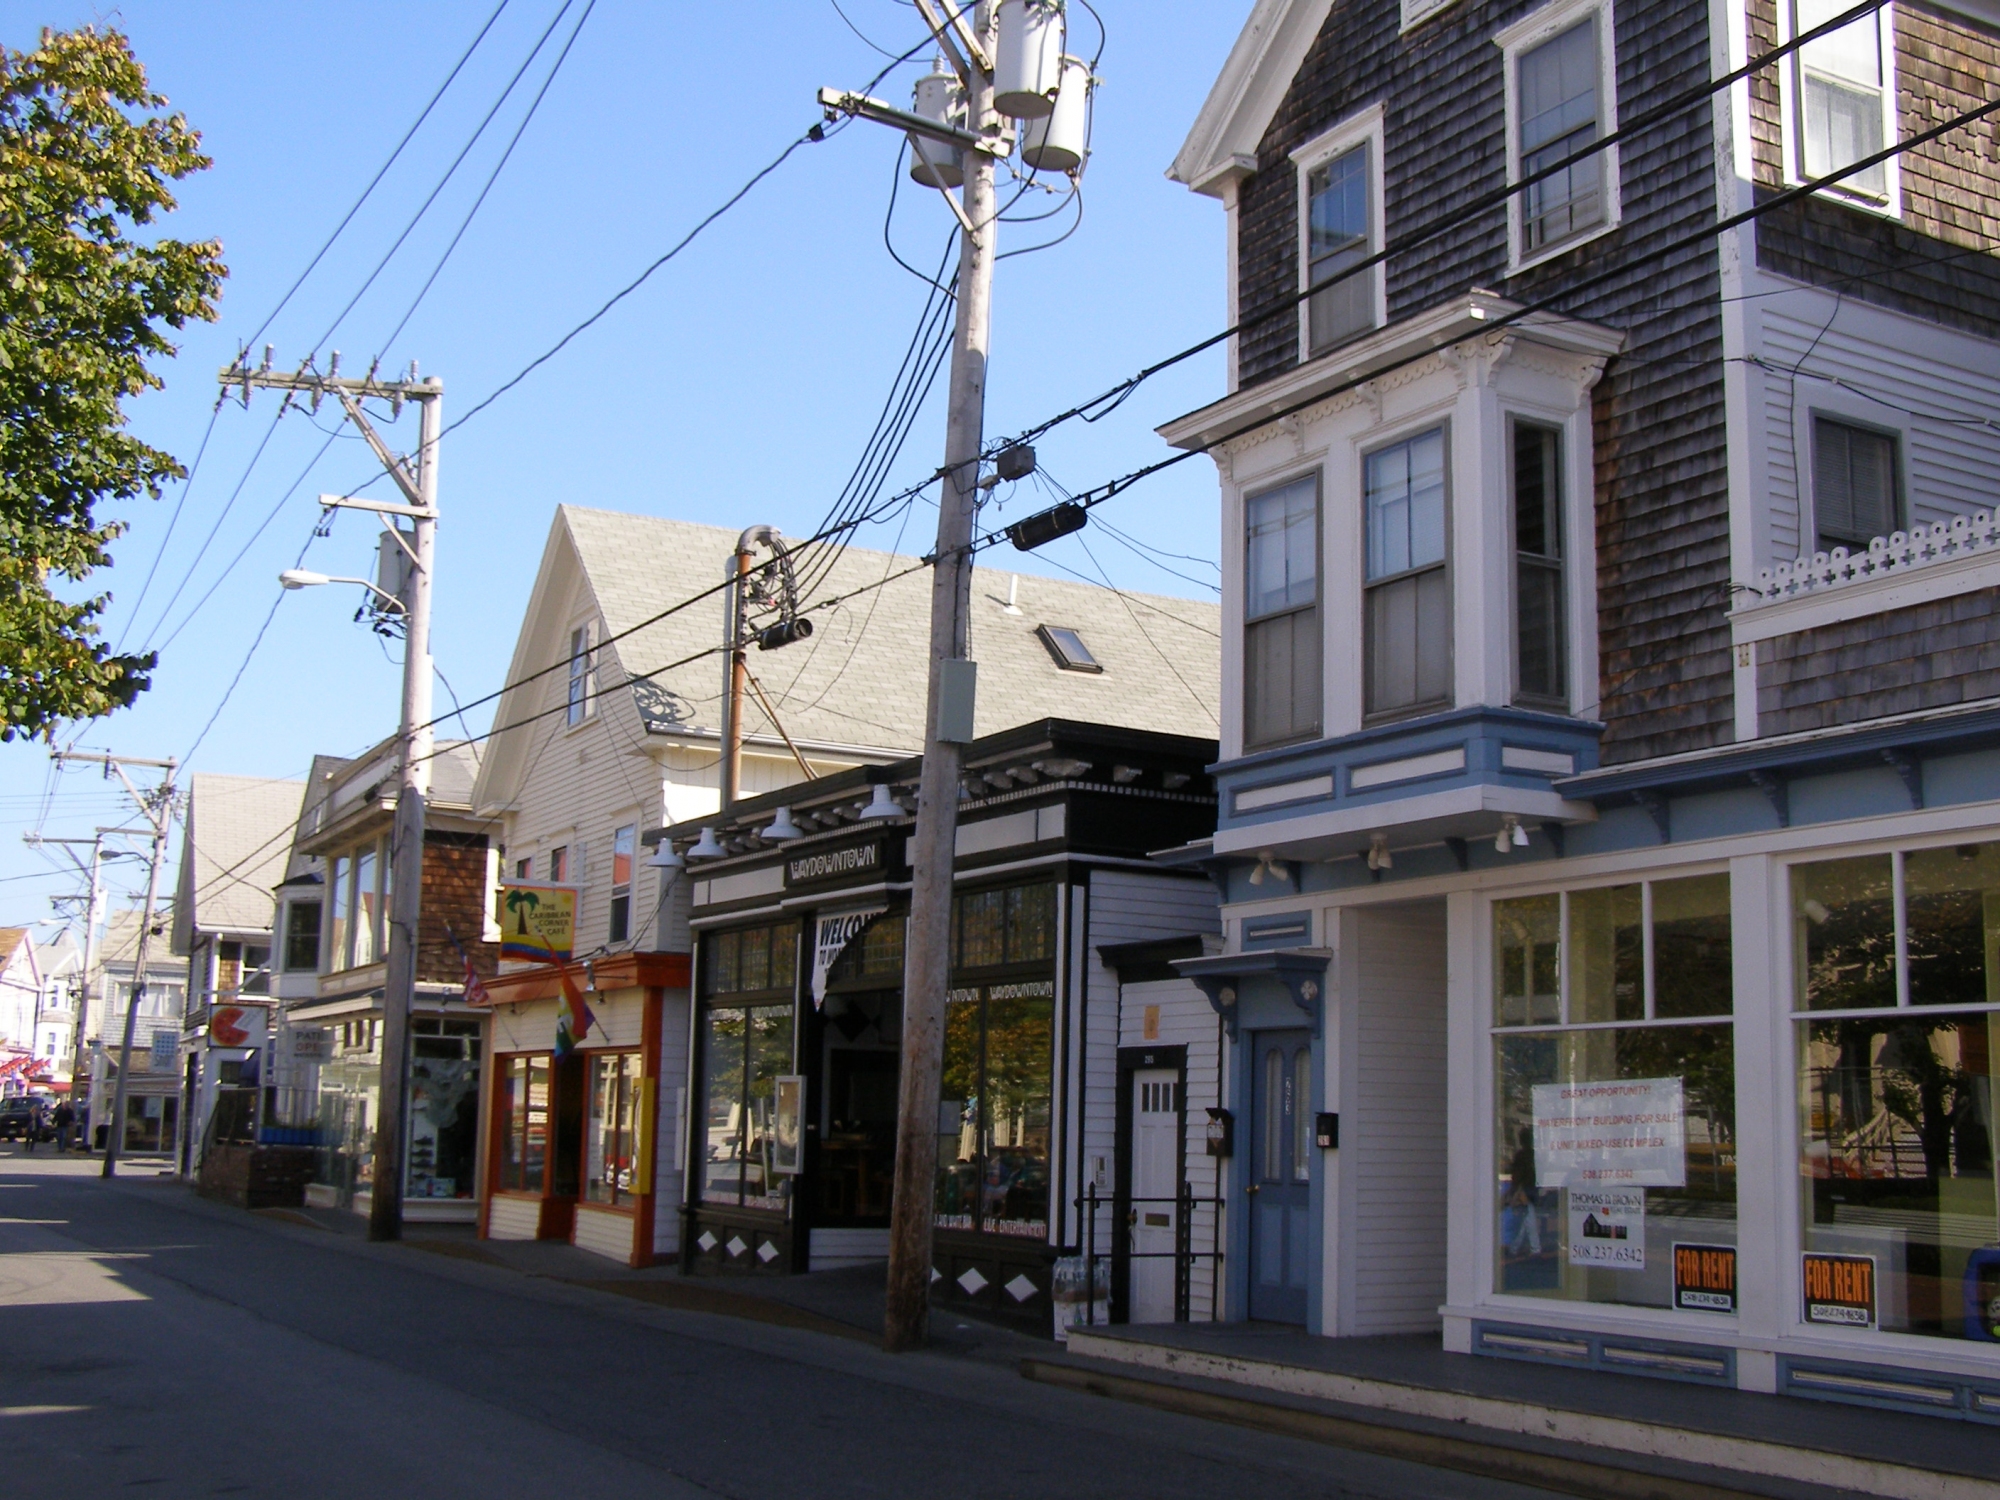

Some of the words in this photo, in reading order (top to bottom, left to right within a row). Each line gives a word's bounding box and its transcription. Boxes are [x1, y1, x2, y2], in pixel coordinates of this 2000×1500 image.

[791, 845, 876, 880] WAYDOWNTOWN
[529, 911, 571, 919] CARIBBEAN
[820, 912, 880, 946] WELCO
[1560, 1088, 1587, 1099] GREAT
[1538, 1117, 1591, 1128] WATERFRONT
[1593, 1115, 1632, 1126] BUILDING
[1634, 1113, 1654, 1124] FOR
[1655, 1112, 1678, 1123] SALE
[1556, 1140, 1574, 1150] UNIT
[1576, 1138, 1622, 1149] MIXED-USE
[1623, 1137, 1665, 1148] COMPLEX
[1571, 1192, 1604, 1205] THOMAS
[1612, 1194, 1641, 1205] BROWN
[1572, 1244, 1643, 1262] 508.237.6342
[1676, 1249, 1700, 1287] FOR
[1702, 1251, 1734, 1290] RENT
[1805, 1259, 1831, 1300] FOR
[1833, 1262, 1871, 1303] RENT
